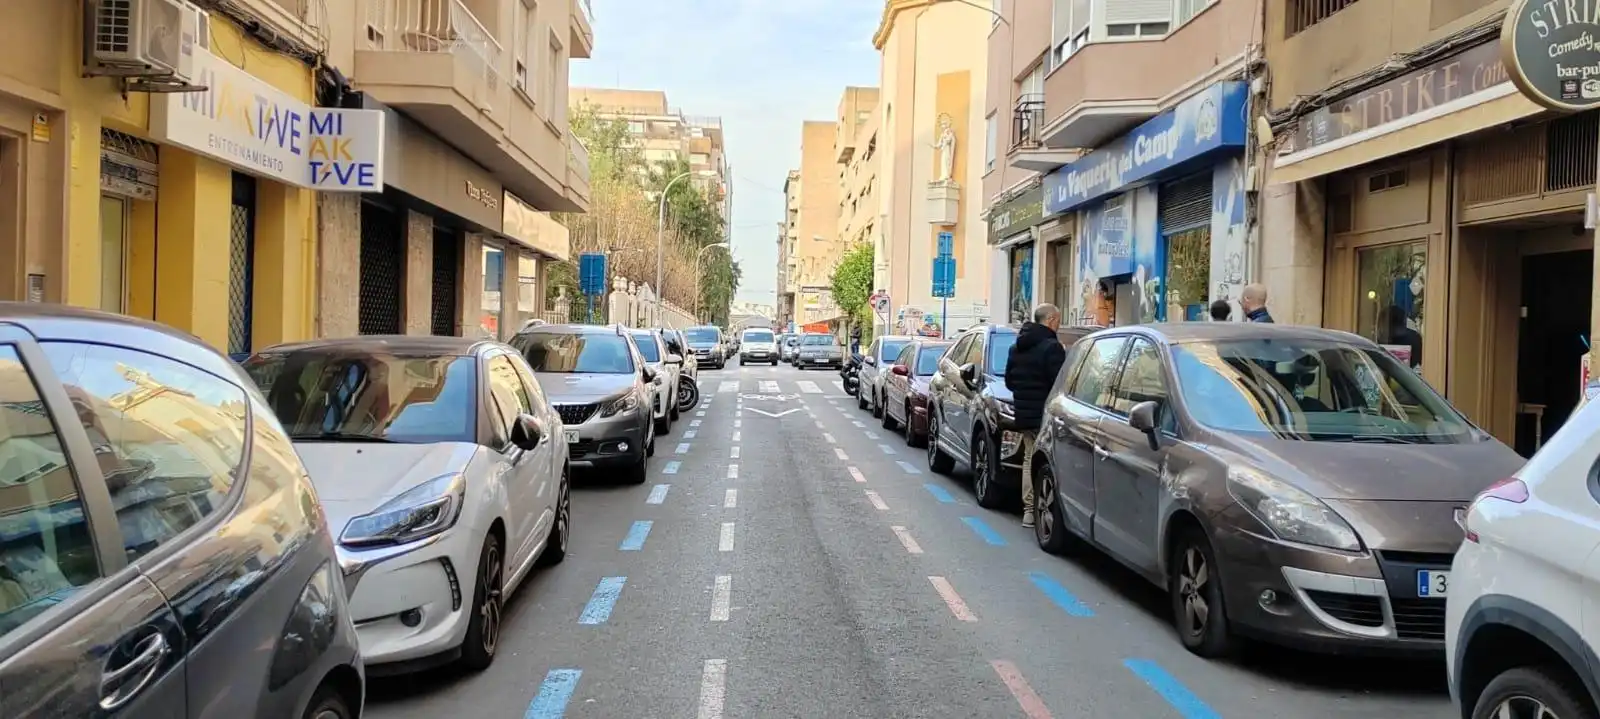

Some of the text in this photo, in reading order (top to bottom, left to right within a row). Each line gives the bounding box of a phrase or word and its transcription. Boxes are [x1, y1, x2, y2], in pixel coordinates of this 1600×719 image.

[1548, 30, 1593, 57] Comedy
[309, 111, 342, 135] MI
[208, 133, 284, 172] ENTRENAMIENTO
[309, 138, 353, 160] AK
